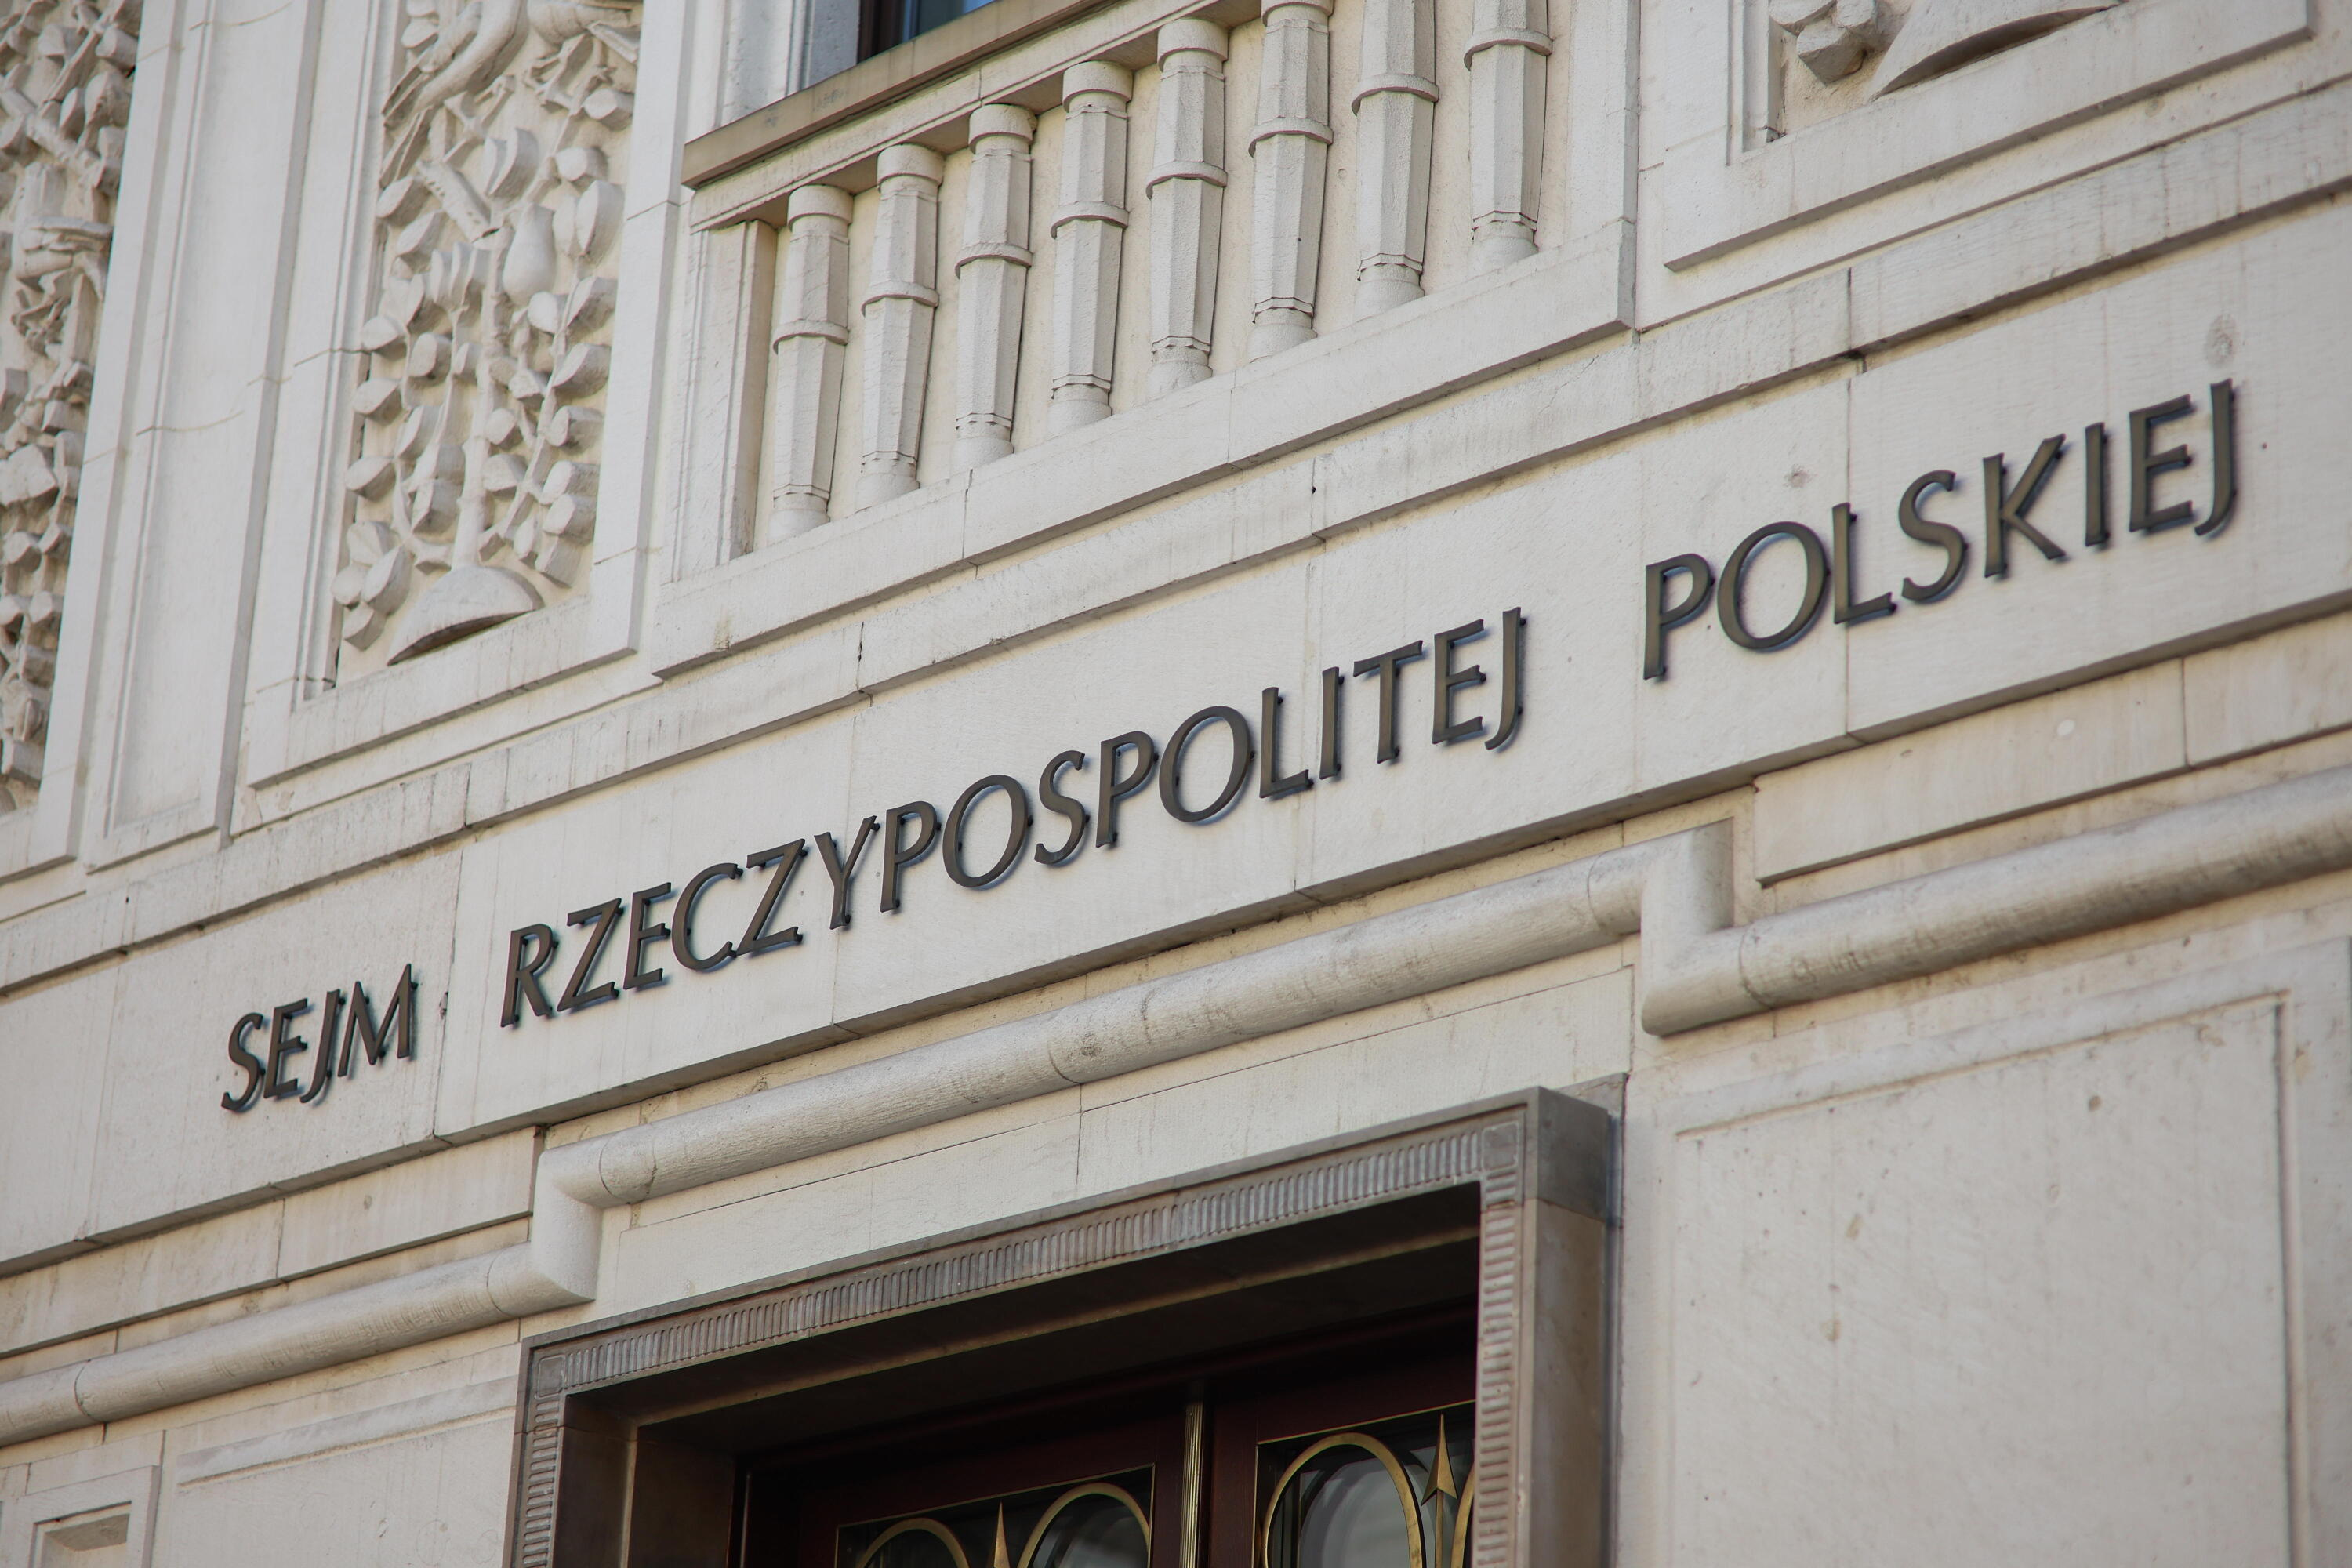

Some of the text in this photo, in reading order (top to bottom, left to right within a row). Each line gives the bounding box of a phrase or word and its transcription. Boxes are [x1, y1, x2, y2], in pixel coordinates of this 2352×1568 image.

[221, 379, 2240, 1113] SEJM RZECZYPOSPOLITEJ POLSKIEJ
